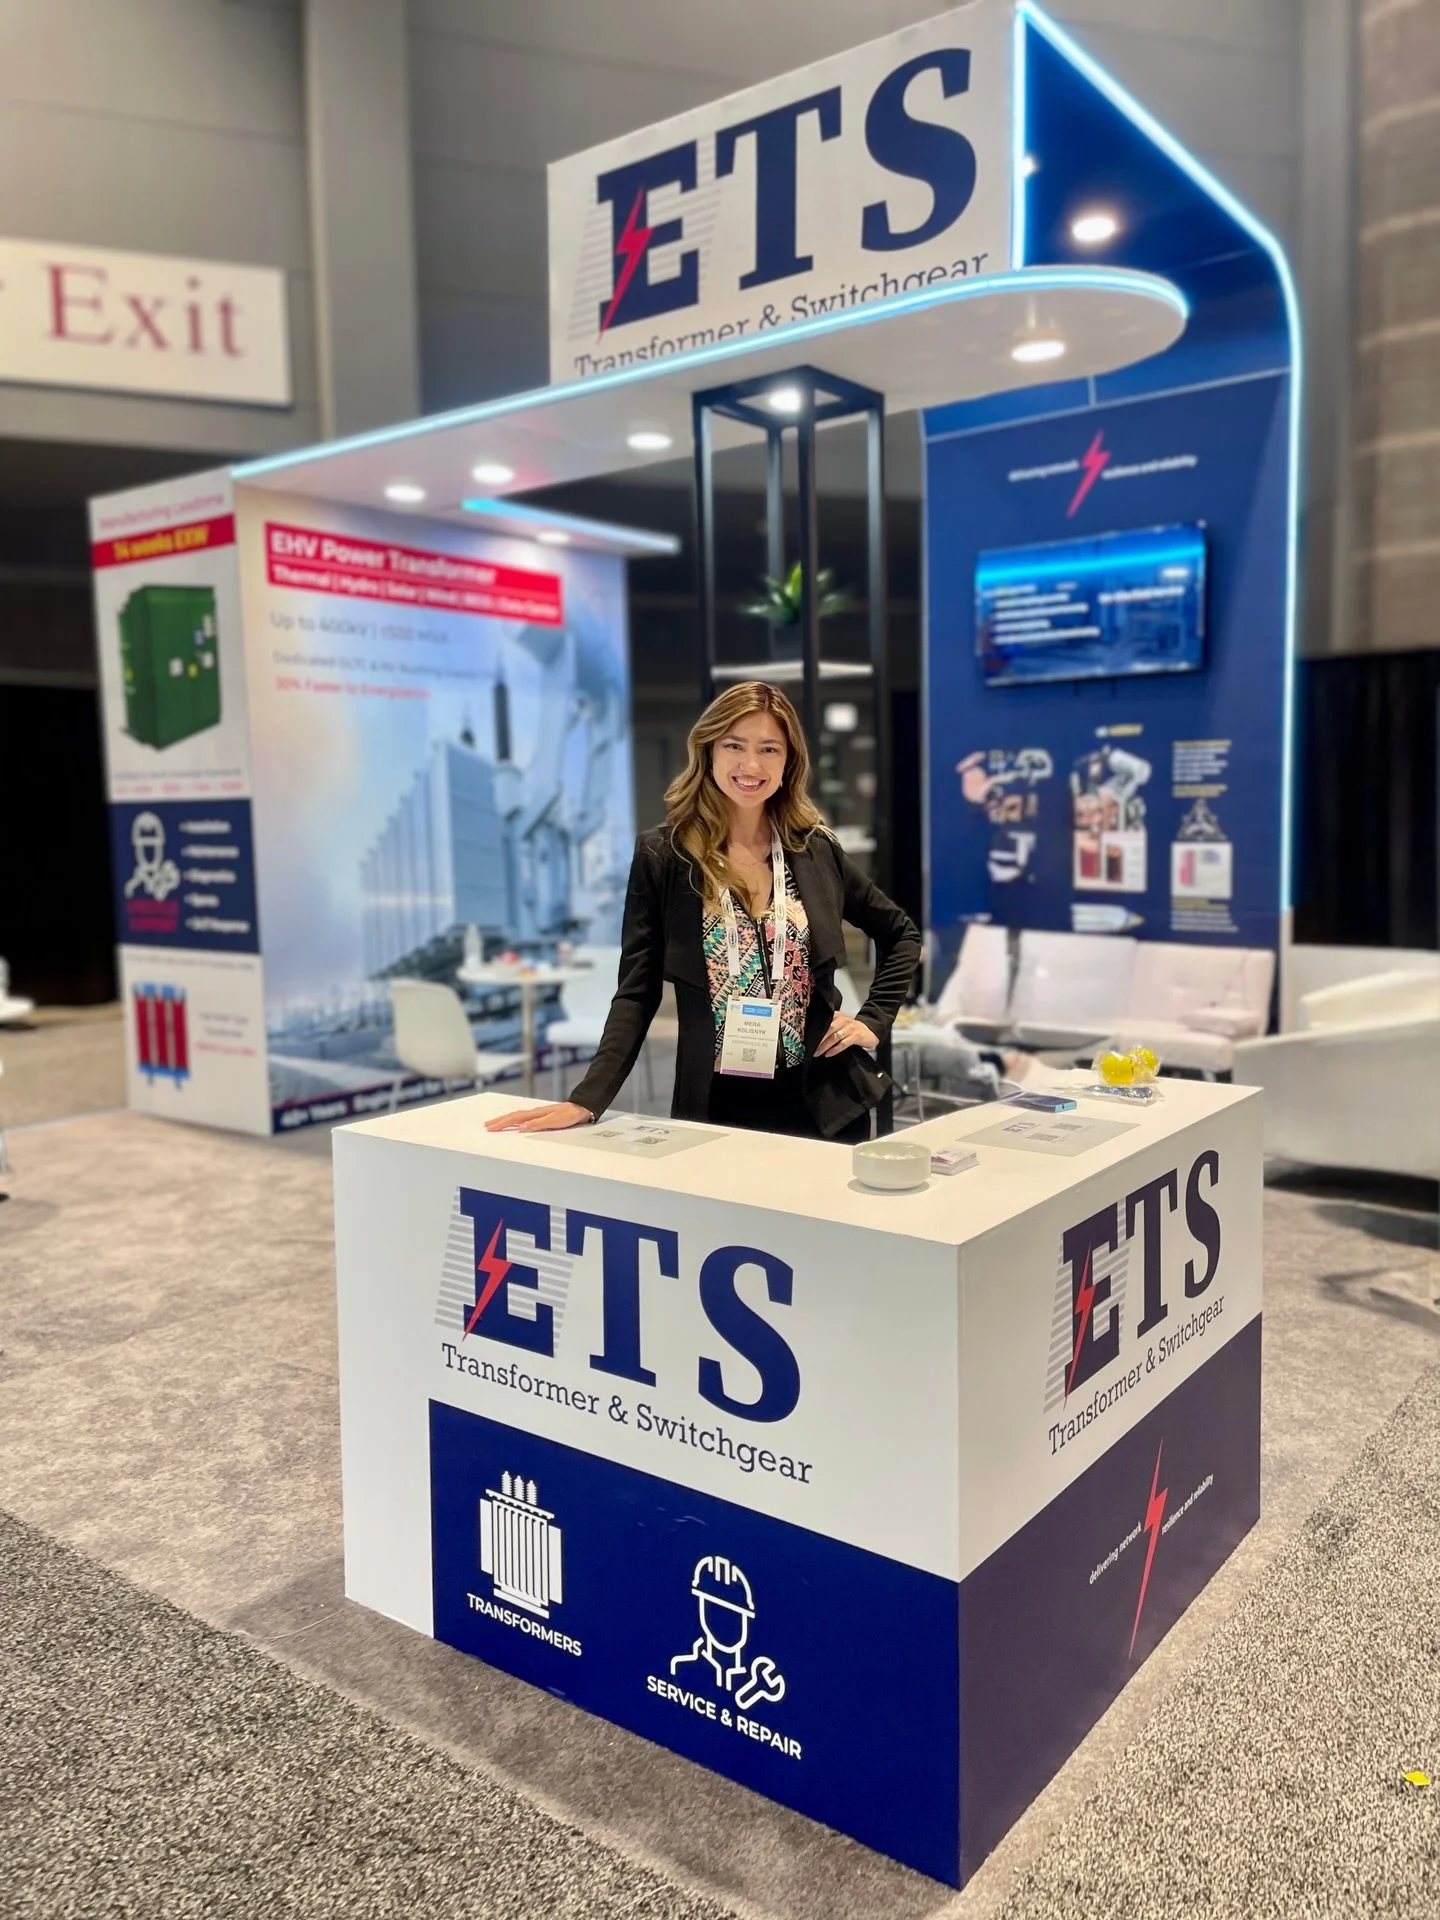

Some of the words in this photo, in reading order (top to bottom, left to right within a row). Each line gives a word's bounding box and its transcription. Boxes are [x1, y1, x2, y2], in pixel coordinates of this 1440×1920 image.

[596, 47, 977, 333] ETS
[43, 261, 245, 358] Exit
[759, 304, 781, 330] &
[271, 530, 319, 559] EHV
[322, 538, 385, 569] Power
[387, 549, 496, 585] Transformer
[272, 564, 331, 589] Thermal
[271, 611, 294, 631] Up
[299, 616, 315, 631] to
[459, 1186, 801, 1424] ETS
[1063, 1149, 1221, 1398] ETS
[441, 1342, 600, 1416] Transformer
[608, 1395, 629, 1425] &
[636, 1403, 813, 1484] Switchgear
[1049, 1363, 1143, 1455] Transformer
[1145, 1347, 1156, 1373] &
[1158, 1296, 1224, 1364] Switchgear
[1089, 1547, 1119, 1585] delivering
[1119, 1521, 1142, 1553] network
[1184, 1493, 1194, 1511] and
[1193, 1473, 1214, 1501] reliability
[467, 1592, 583, 1656] TRANSFORMERS
[647, 1675, 716, 1721] SERVICE
[721, 1708, 733, 1728] &
[737, 1715, 802, 1760] REPAIR
